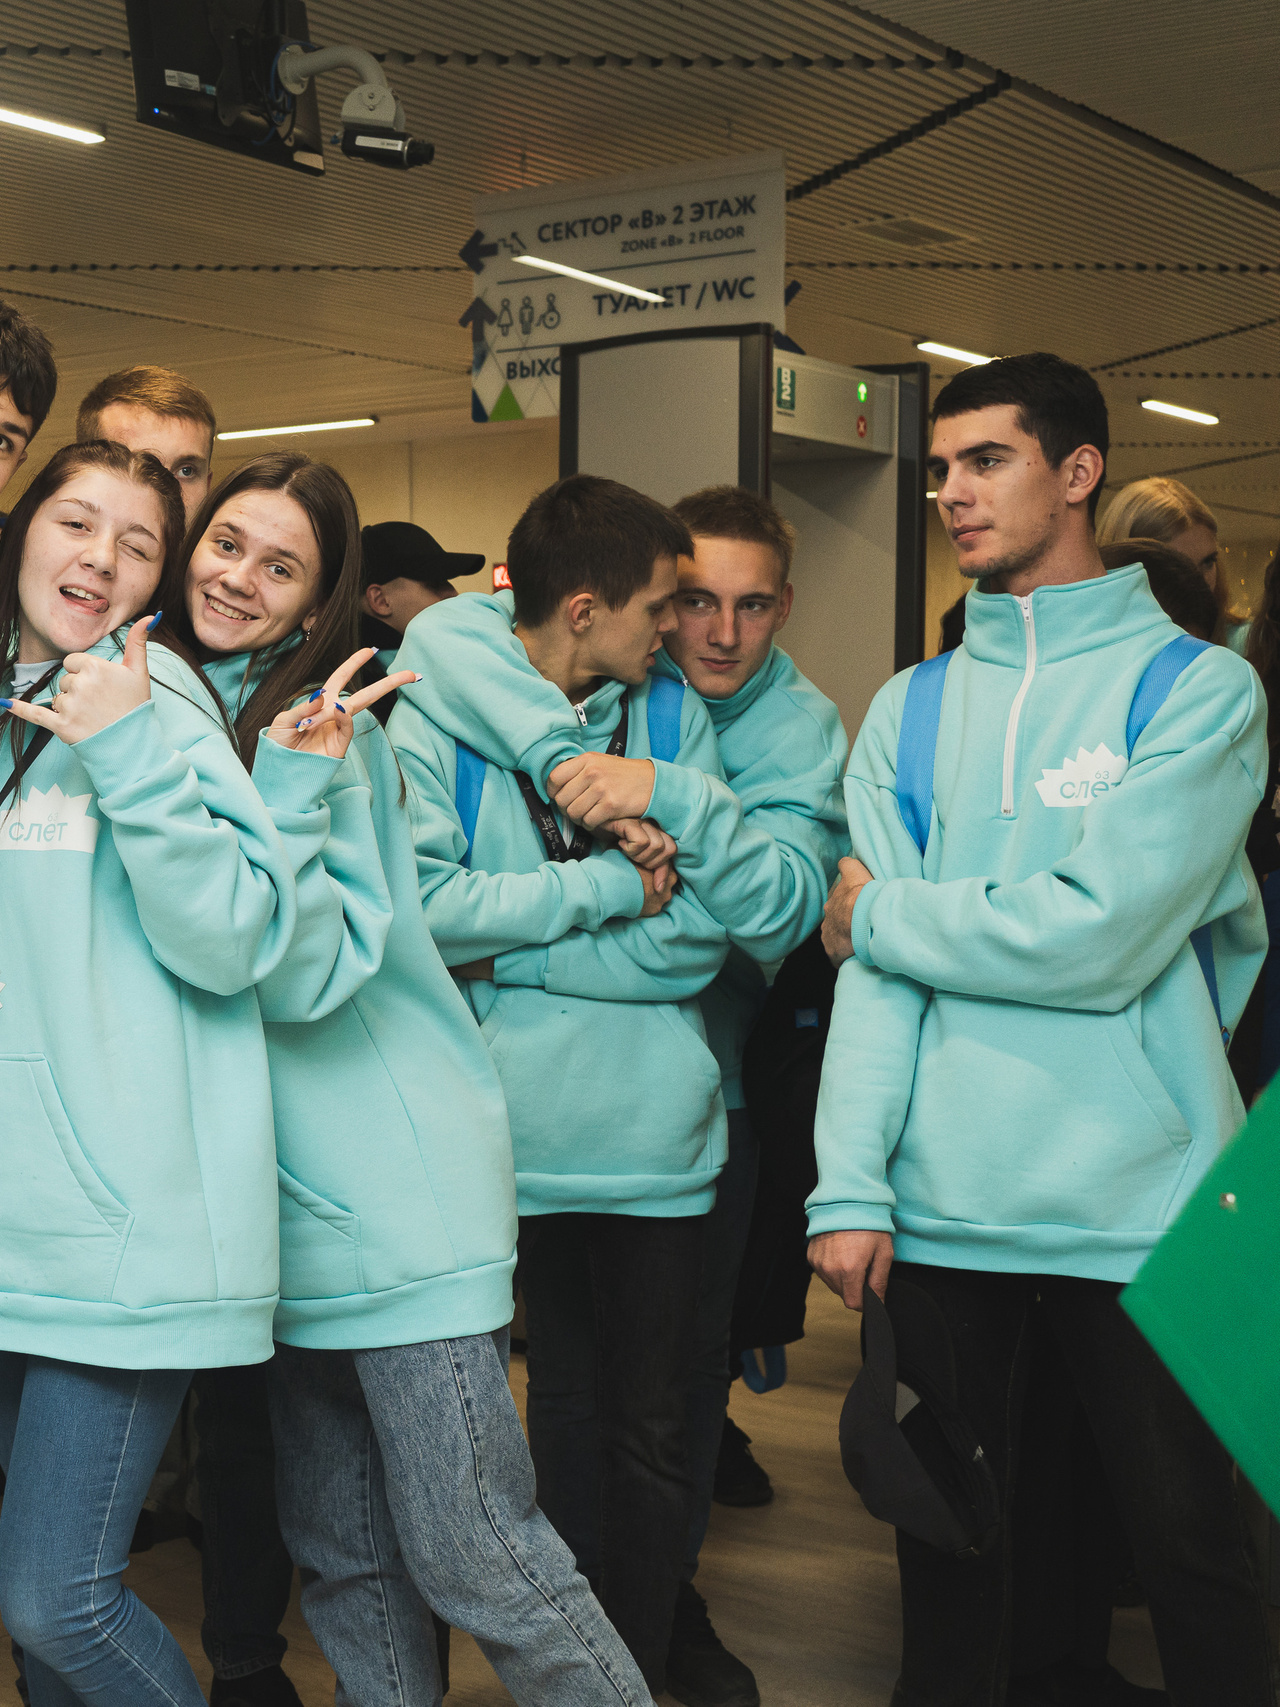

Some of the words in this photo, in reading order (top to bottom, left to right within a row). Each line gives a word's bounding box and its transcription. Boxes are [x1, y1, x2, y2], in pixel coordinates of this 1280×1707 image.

[538, 214, 622, 243] СЕКТОР
[628, 209, 666, 230] «В»
[672, 205, 684, 225] 2
[689, 194, 756, 223] ЭТАЖ
[621, 236, 657, 253] ZONE
[689, 232, 696, 245] 2
[699, 225, 745, 243] FLOOR
[712, 276, 755, 302] WC
[1095, 770, 1109, 780] 63
[9, 822, 68, 843] слет
